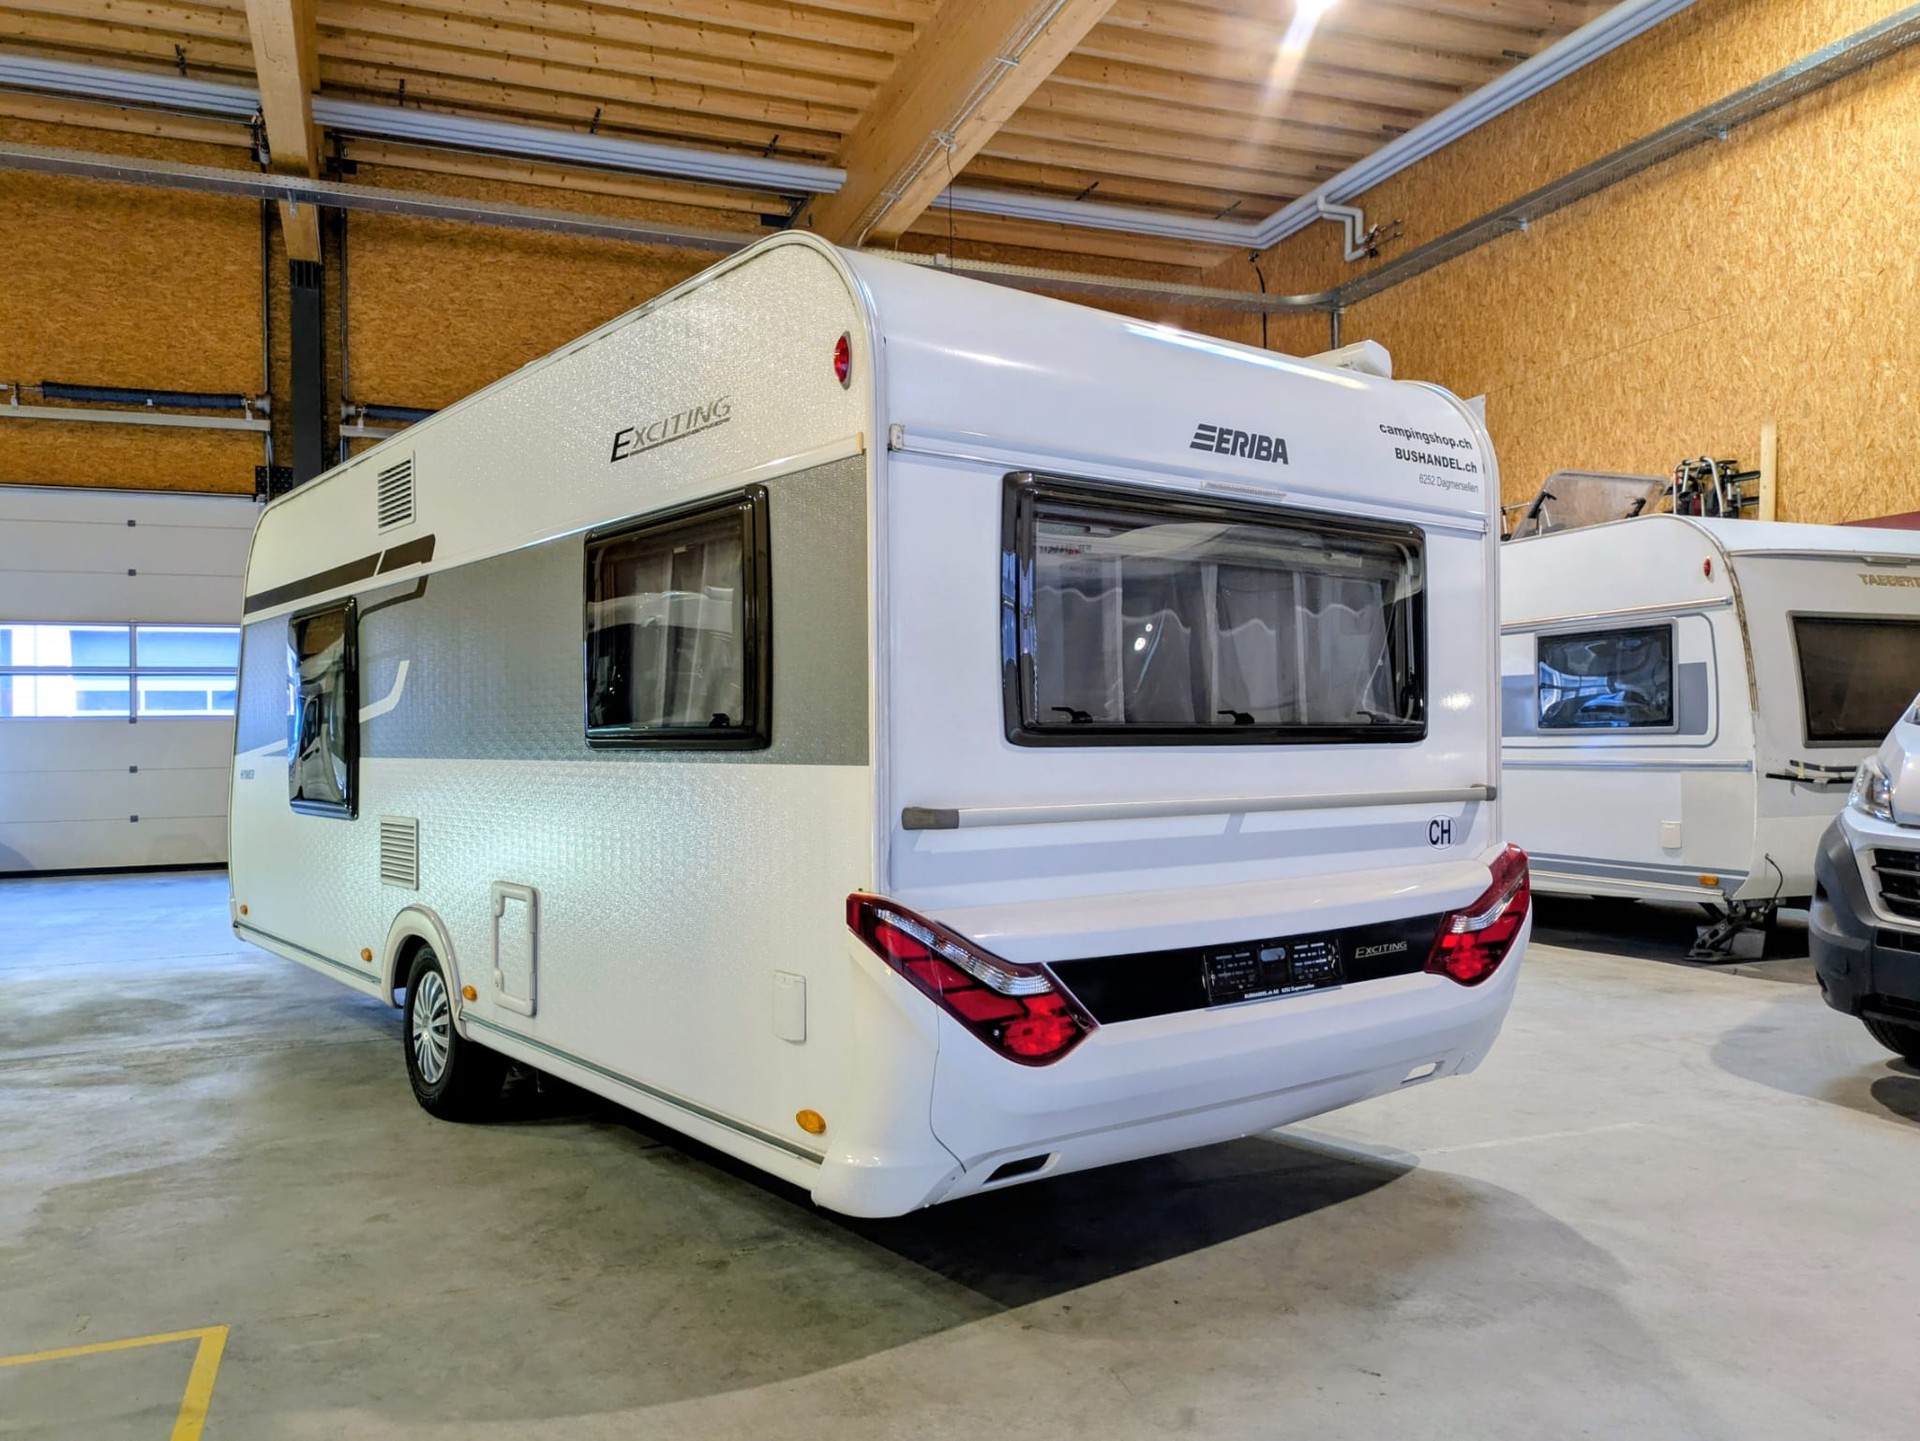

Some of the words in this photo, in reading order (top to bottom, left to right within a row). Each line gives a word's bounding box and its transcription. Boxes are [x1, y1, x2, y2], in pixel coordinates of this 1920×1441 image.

[611, 395, 731, 462] EXCITING
[1379, 424, 1472, 450] campingshop.ch
[1214, 427, 1289, 465] ERIBA
[1394, 447, 1478, 473] BUSHANDEL.ch
[1418, 473, 1436, 486] 6252
[1429, 819, 1451, 845] CH
[1355, 940, 1407, 958] EXCITING
